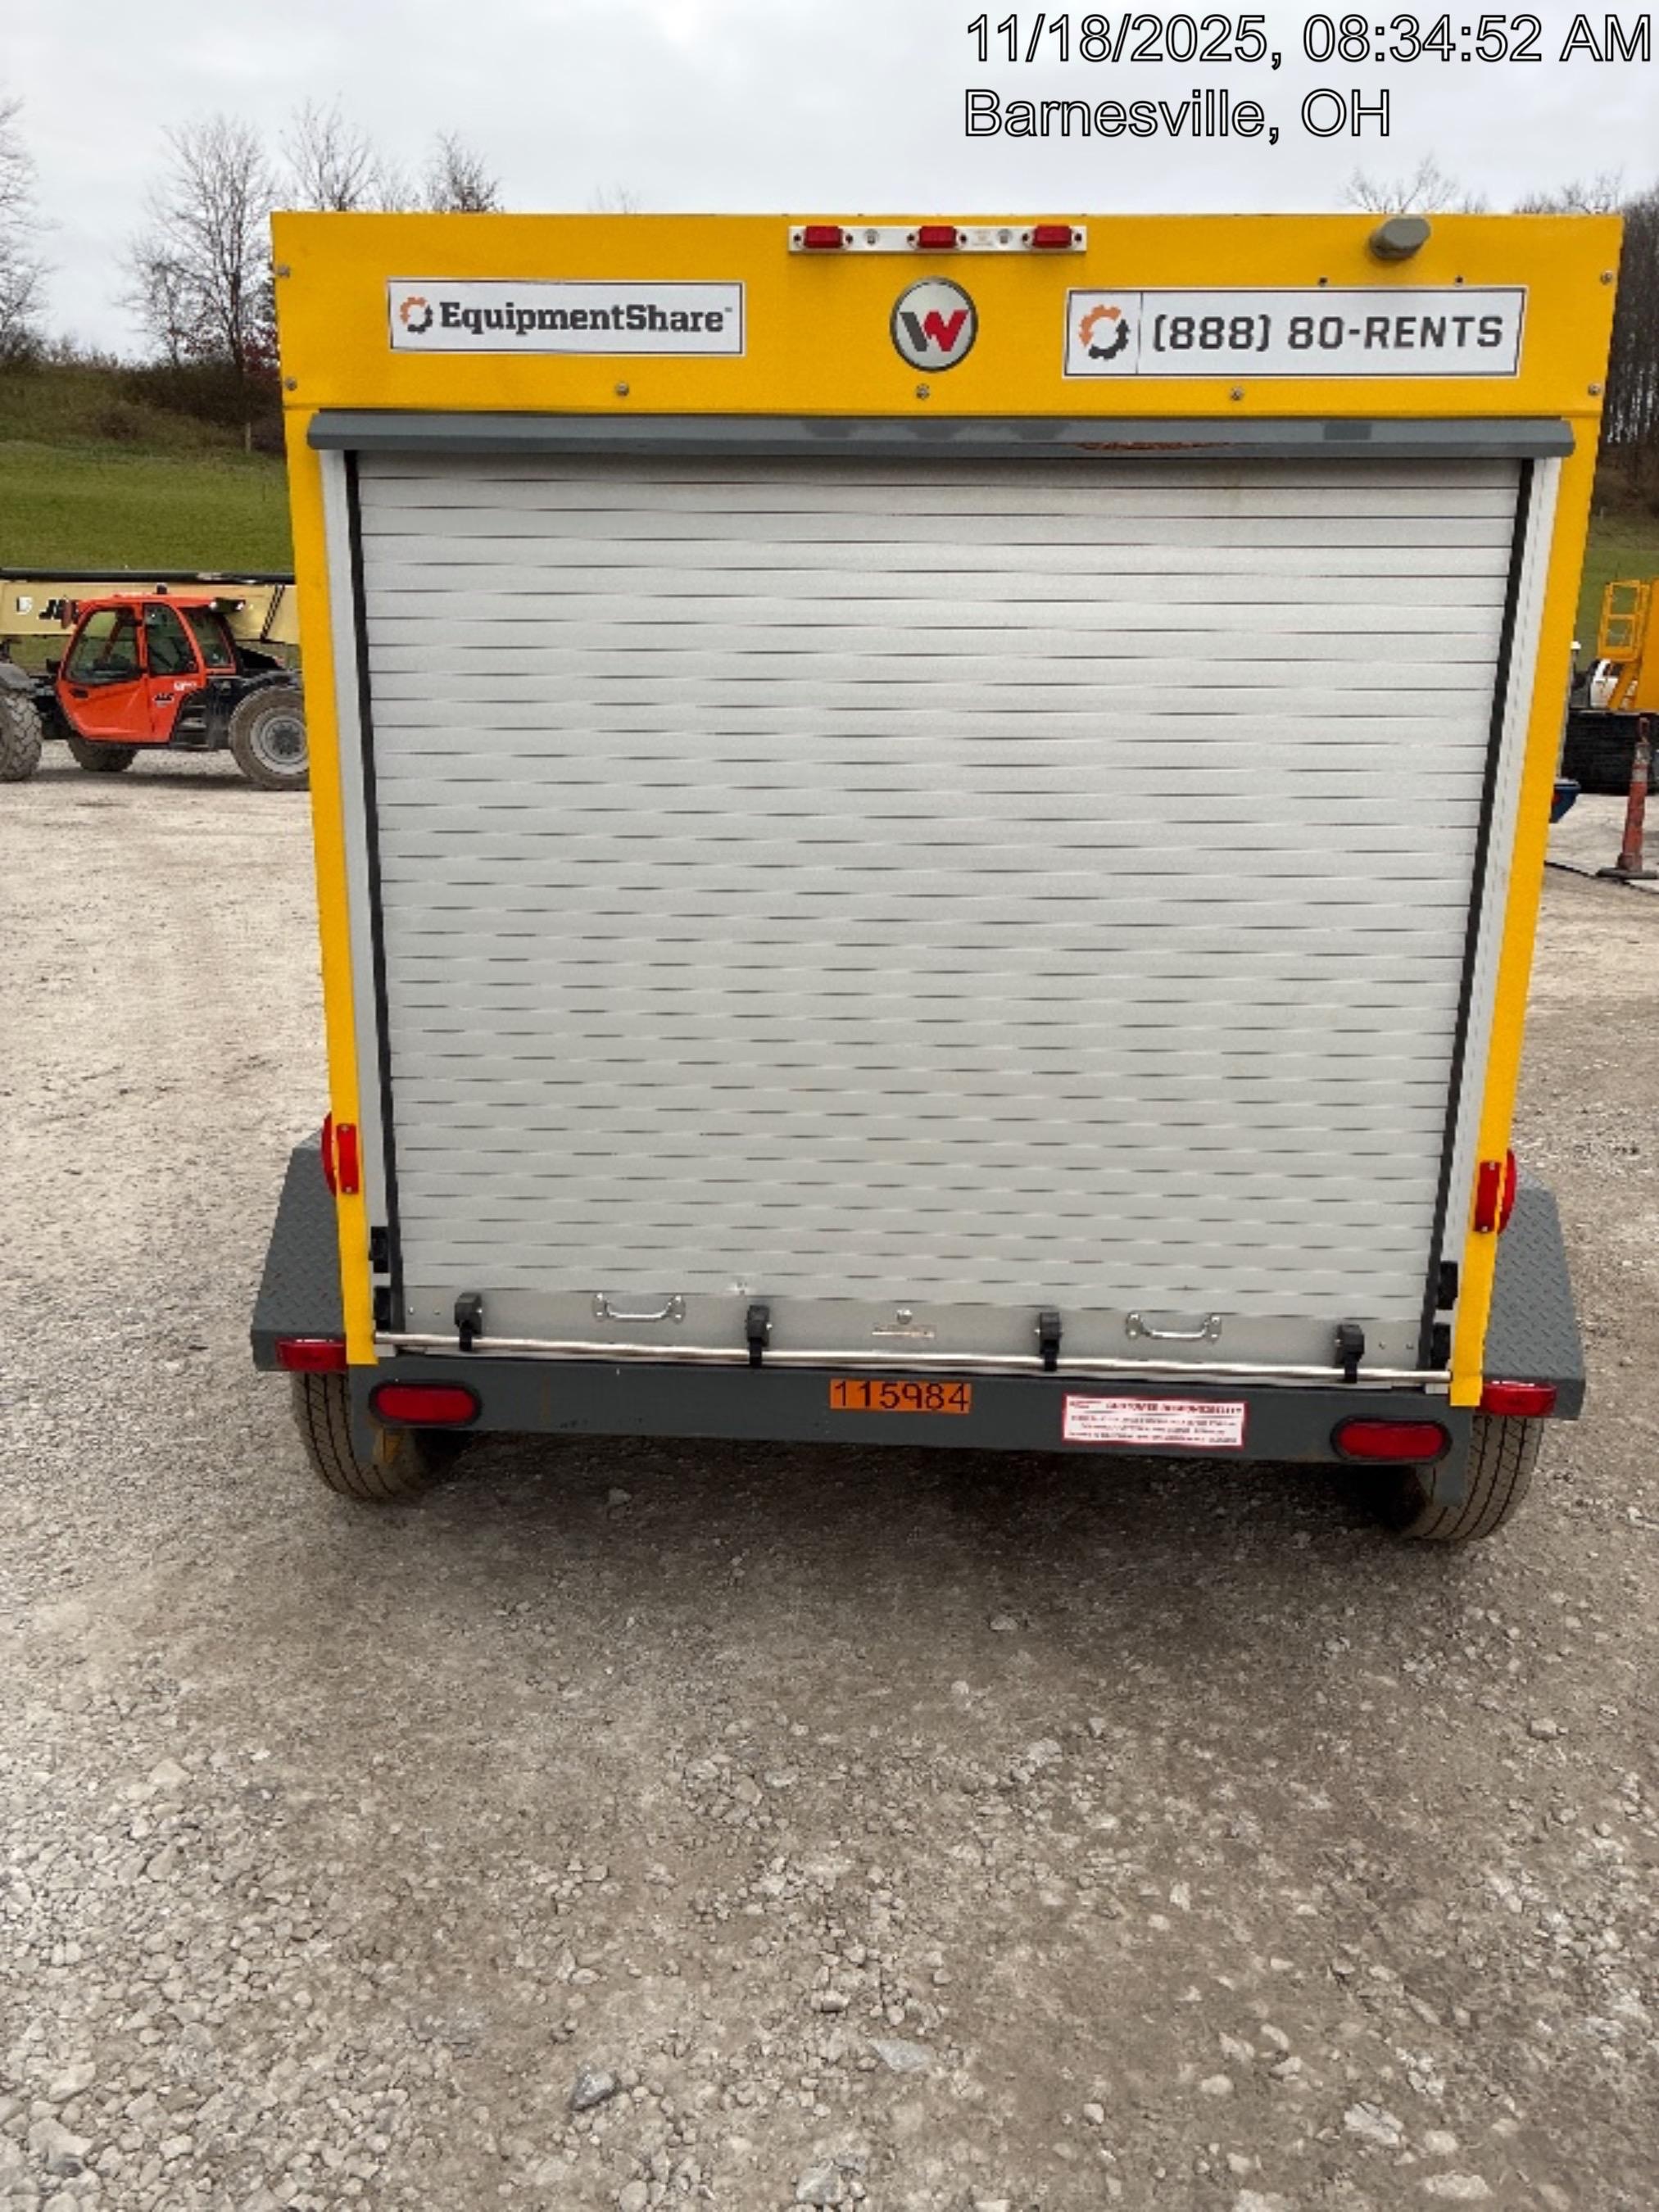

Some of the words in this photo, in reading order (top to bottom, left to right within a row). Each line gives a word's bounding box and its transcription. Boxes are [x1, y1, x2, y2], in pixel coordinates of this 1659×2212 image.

[440, 301, 724, 335] EquipmentShare
[1153, 314, 1271, 352] (888)
[1288, 315, 1503, 349] 80-RENTS
[834, 1380, 969, 1412] 115984
